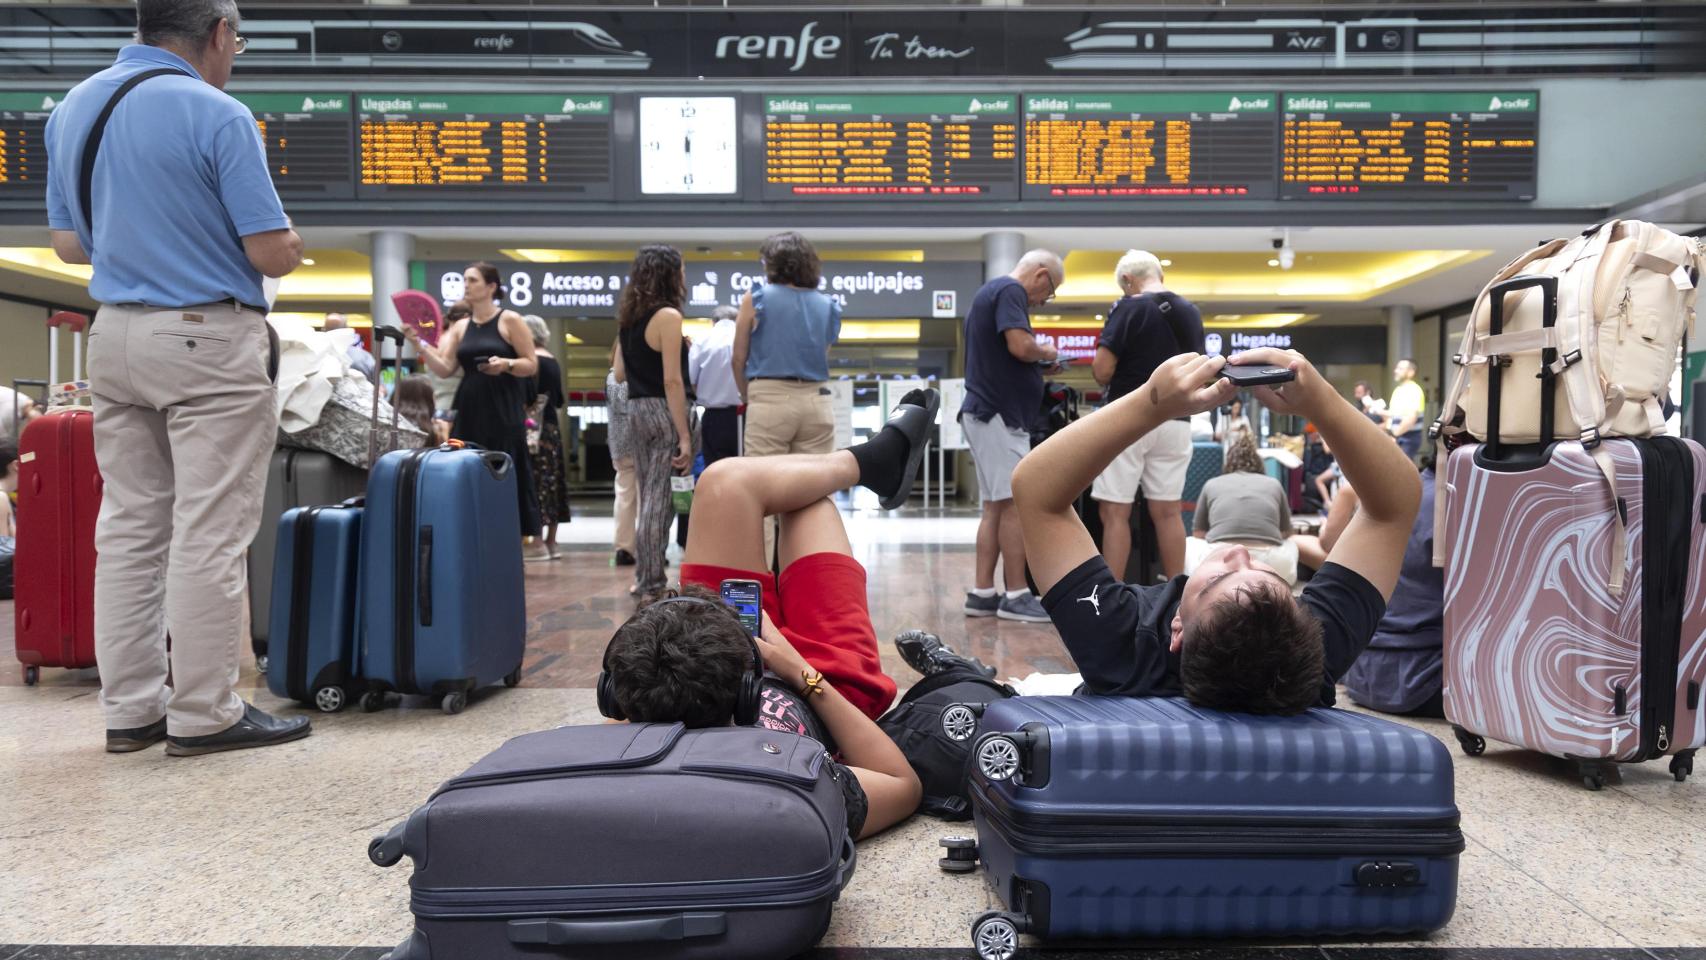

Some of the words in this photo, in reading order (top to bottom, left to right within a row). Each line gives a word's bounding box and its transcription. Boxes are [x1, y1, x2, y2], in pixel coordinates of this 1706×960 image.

[474, 33, 515, 51] renfe
[715, 21, 841, 72] renfe
[865, 32, 900, 61] Tu
[903, 35, 975, 59] tren
[1286, 36, 1327, 49] AVE
[361, 98, 413, 112] Llegadas
[769, 100, 809, 112] Salidas
[1028, 98, 1069, 111] Salidas
[1287, 98, 1328, 110] Salidas
[542, 272, 604, 291] Acceso
[608, 275, 621, 291] a
[832, 271, 924, 294] equipajes
[542, 294, 615, 306] PLATFORMS
[1058, 335, 1096, 349] pasar
[1230, 332, 1291, 348] Llegadas
